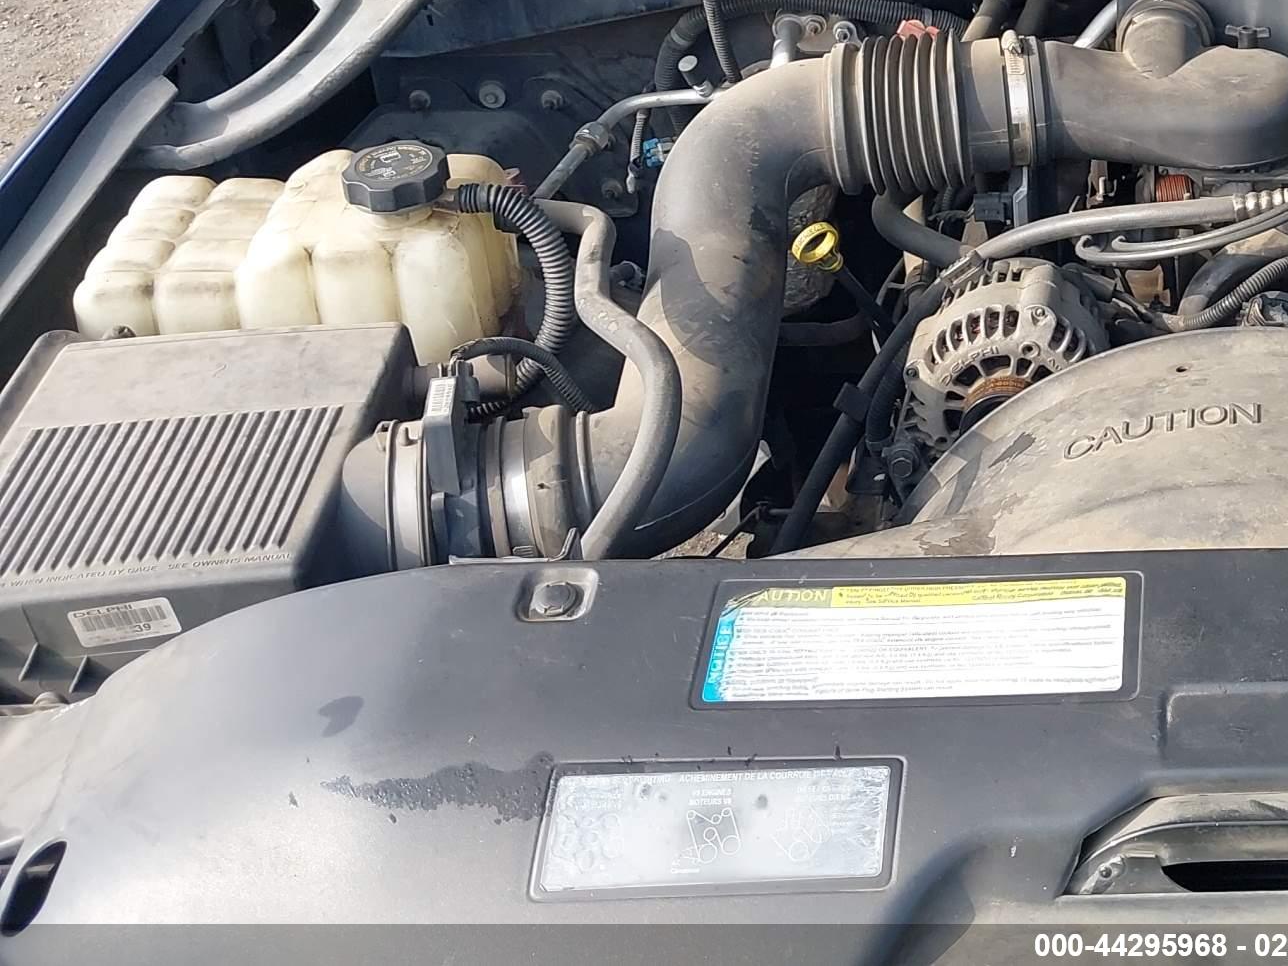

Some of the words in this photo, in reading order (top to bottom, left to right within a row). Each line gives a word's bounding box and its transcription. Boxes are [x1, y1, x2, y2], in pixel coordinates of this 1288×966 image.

[940, 345, 999, 386] DELPHI
[1062, 402, 1263, 462] CAUTION
[750, 589, 828, 603] AUTION
[73, 604, 133, 619] DELPHI
[135, 622, 152, 633] 39
[708, 624, 734, 684] NOTICE
